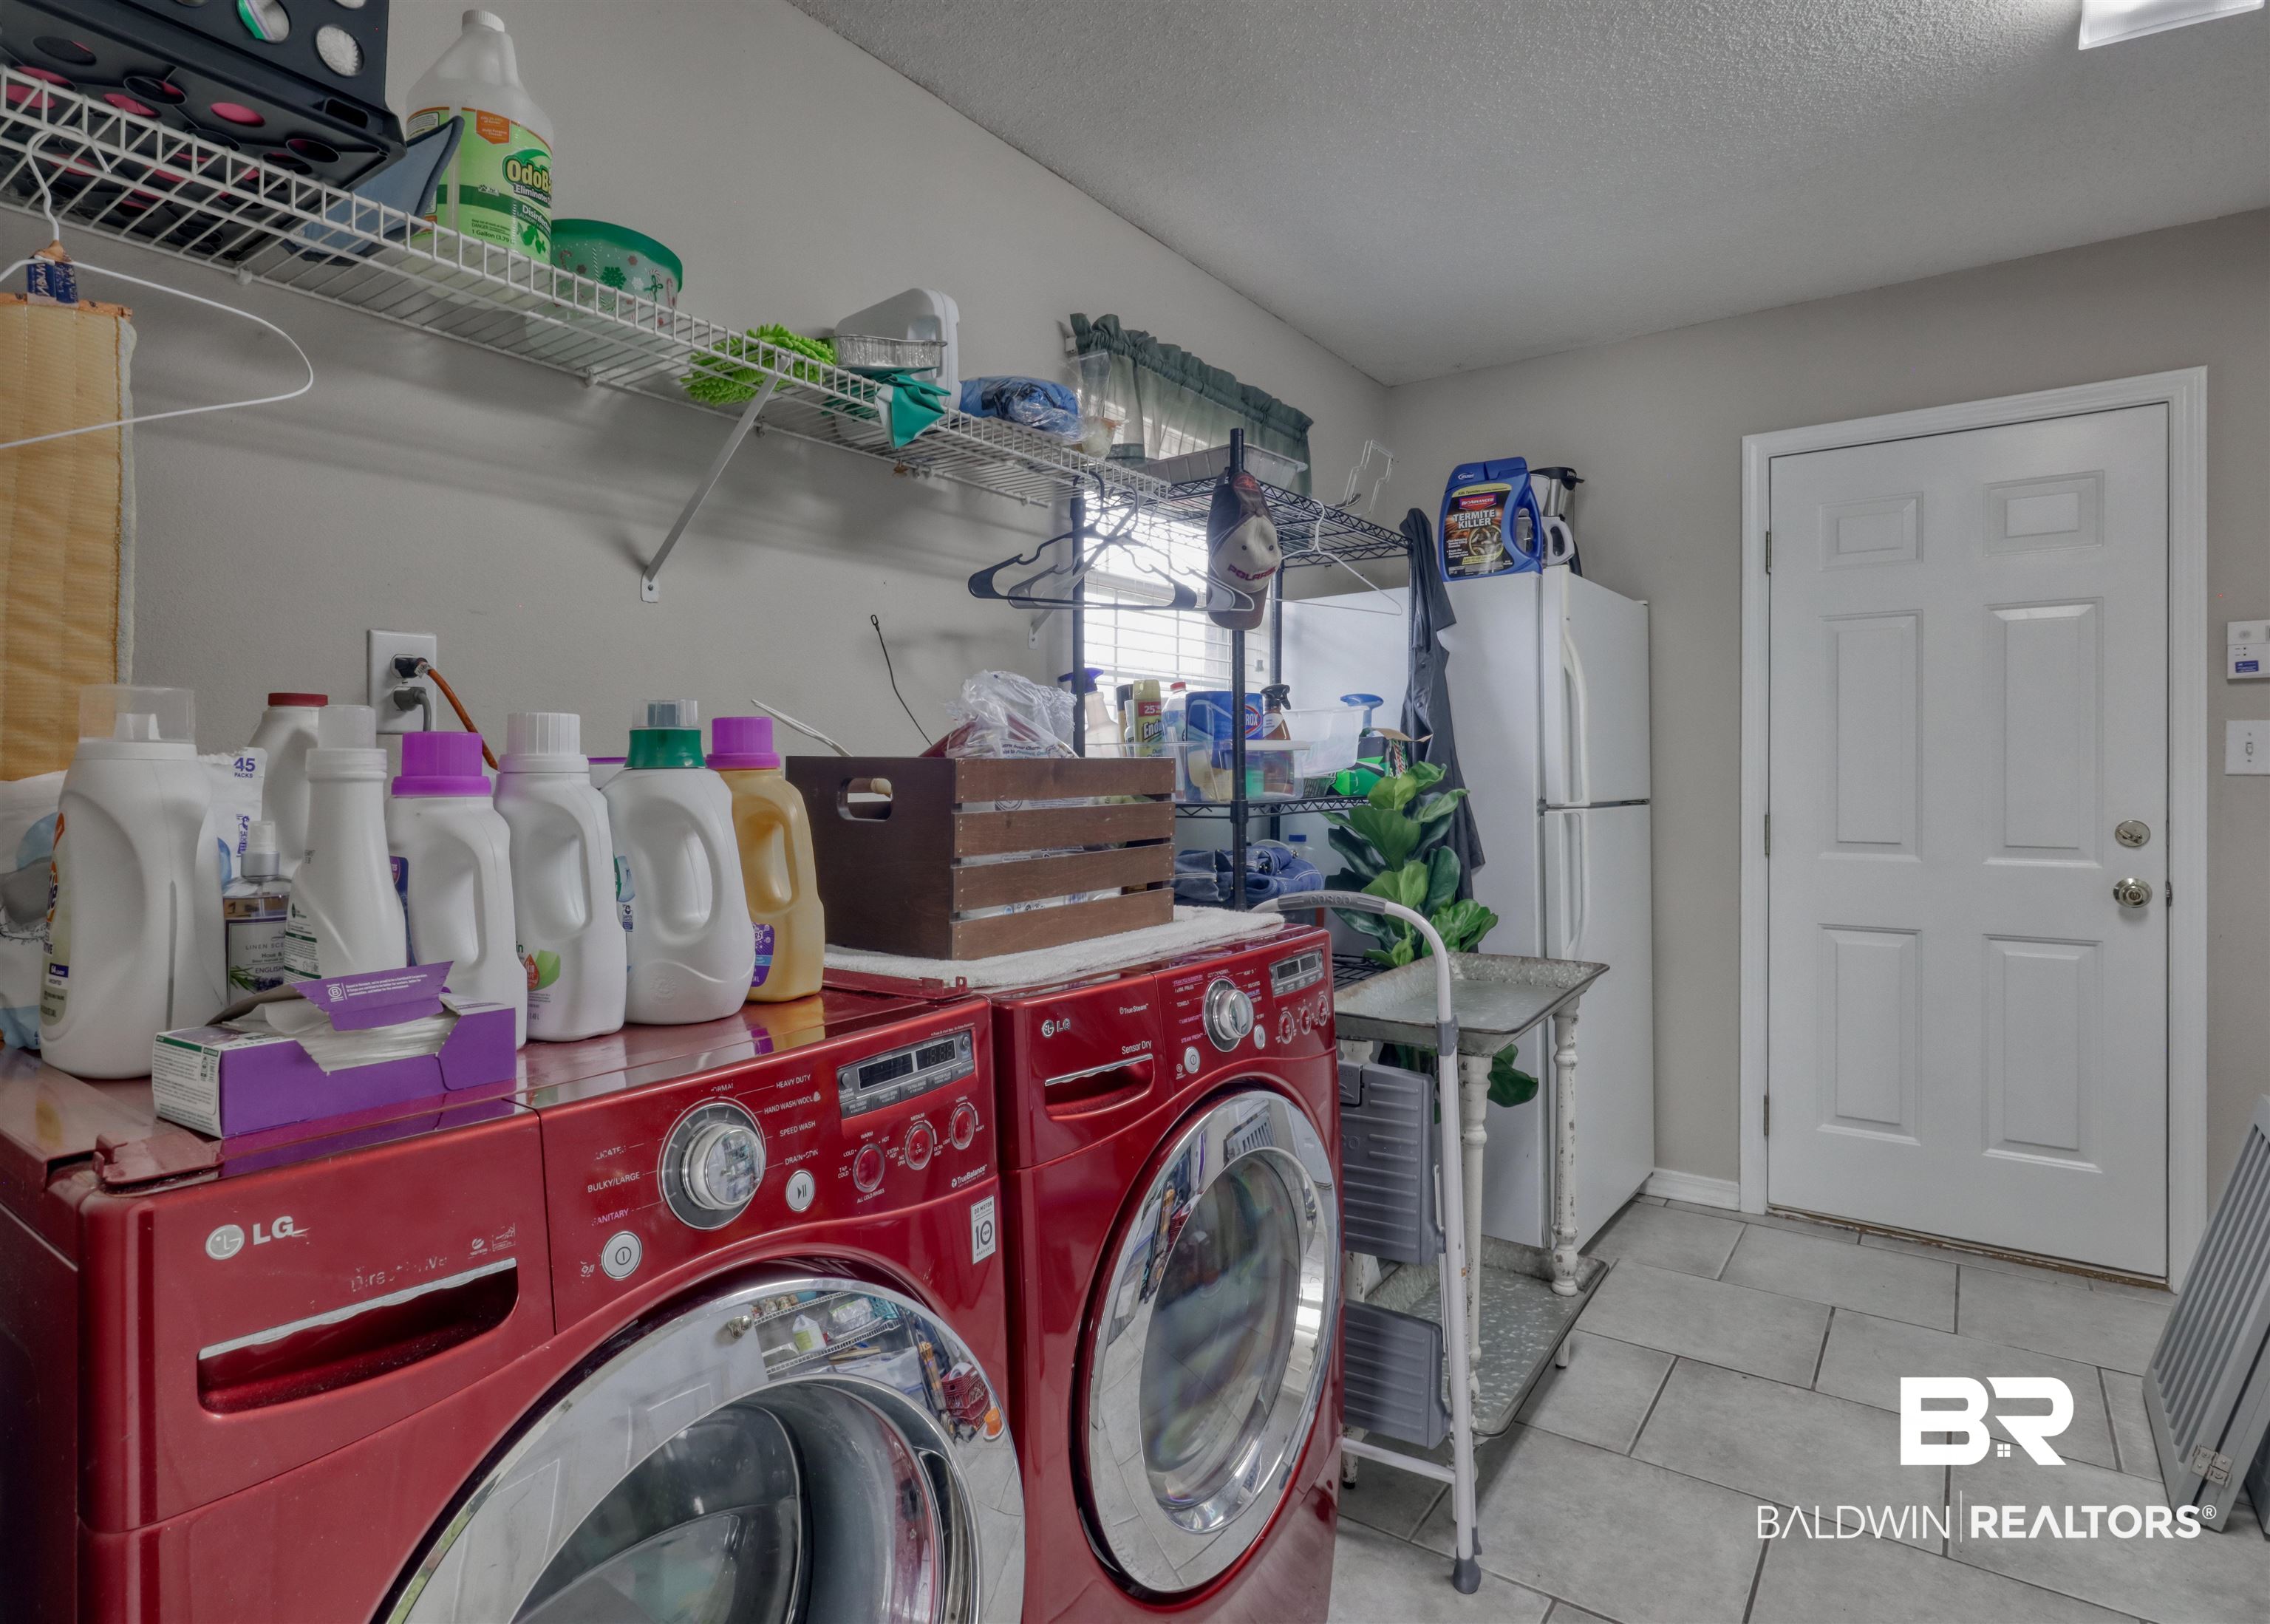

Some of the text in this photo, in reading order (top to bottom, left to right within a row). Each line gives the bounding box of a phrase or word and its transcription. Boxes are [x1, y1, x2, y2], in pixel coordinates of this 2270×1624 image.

[476, 229, 495, 239] Gallon
[1453, 509, 1495, 522] TERMITE
[1458, 518, 1491, 529] KILLER
[1245, 712, 1258, 727] ROX
[1143, 719, 1163, 740] Endu
[234, 757, 256, 771] 45
[1057, 1018, 1070, 1032] LG
[1122, 1040, 1153, 1055] Sensor Dry
[776, 1074, 811, 1088] HEAVY DUTY
[764, 1096, 813, 1115] HAND WASH/WOOL
[910, 1113, 925, 1121] MEDIUM
[780, 1121, 816, 1137] SPEED WASH
[860, 1131, 873, 1139] WARM
[843, 1150, 854, 1158] COLD
[887, 1147, 899, 1156] EXTRA
[838, 1170, 849, 1178] COLD
[587, 1172, 641, 1193] BULKY/LARGE
[863, 1193, 873, 1201] COLD
[873, 1188, 885, 1198] RINSES
[980, 1200, 992, 1212] MOTOR
[253, 1215, 294, 1245] LG
[975, 1220, 993, 1250] 10
